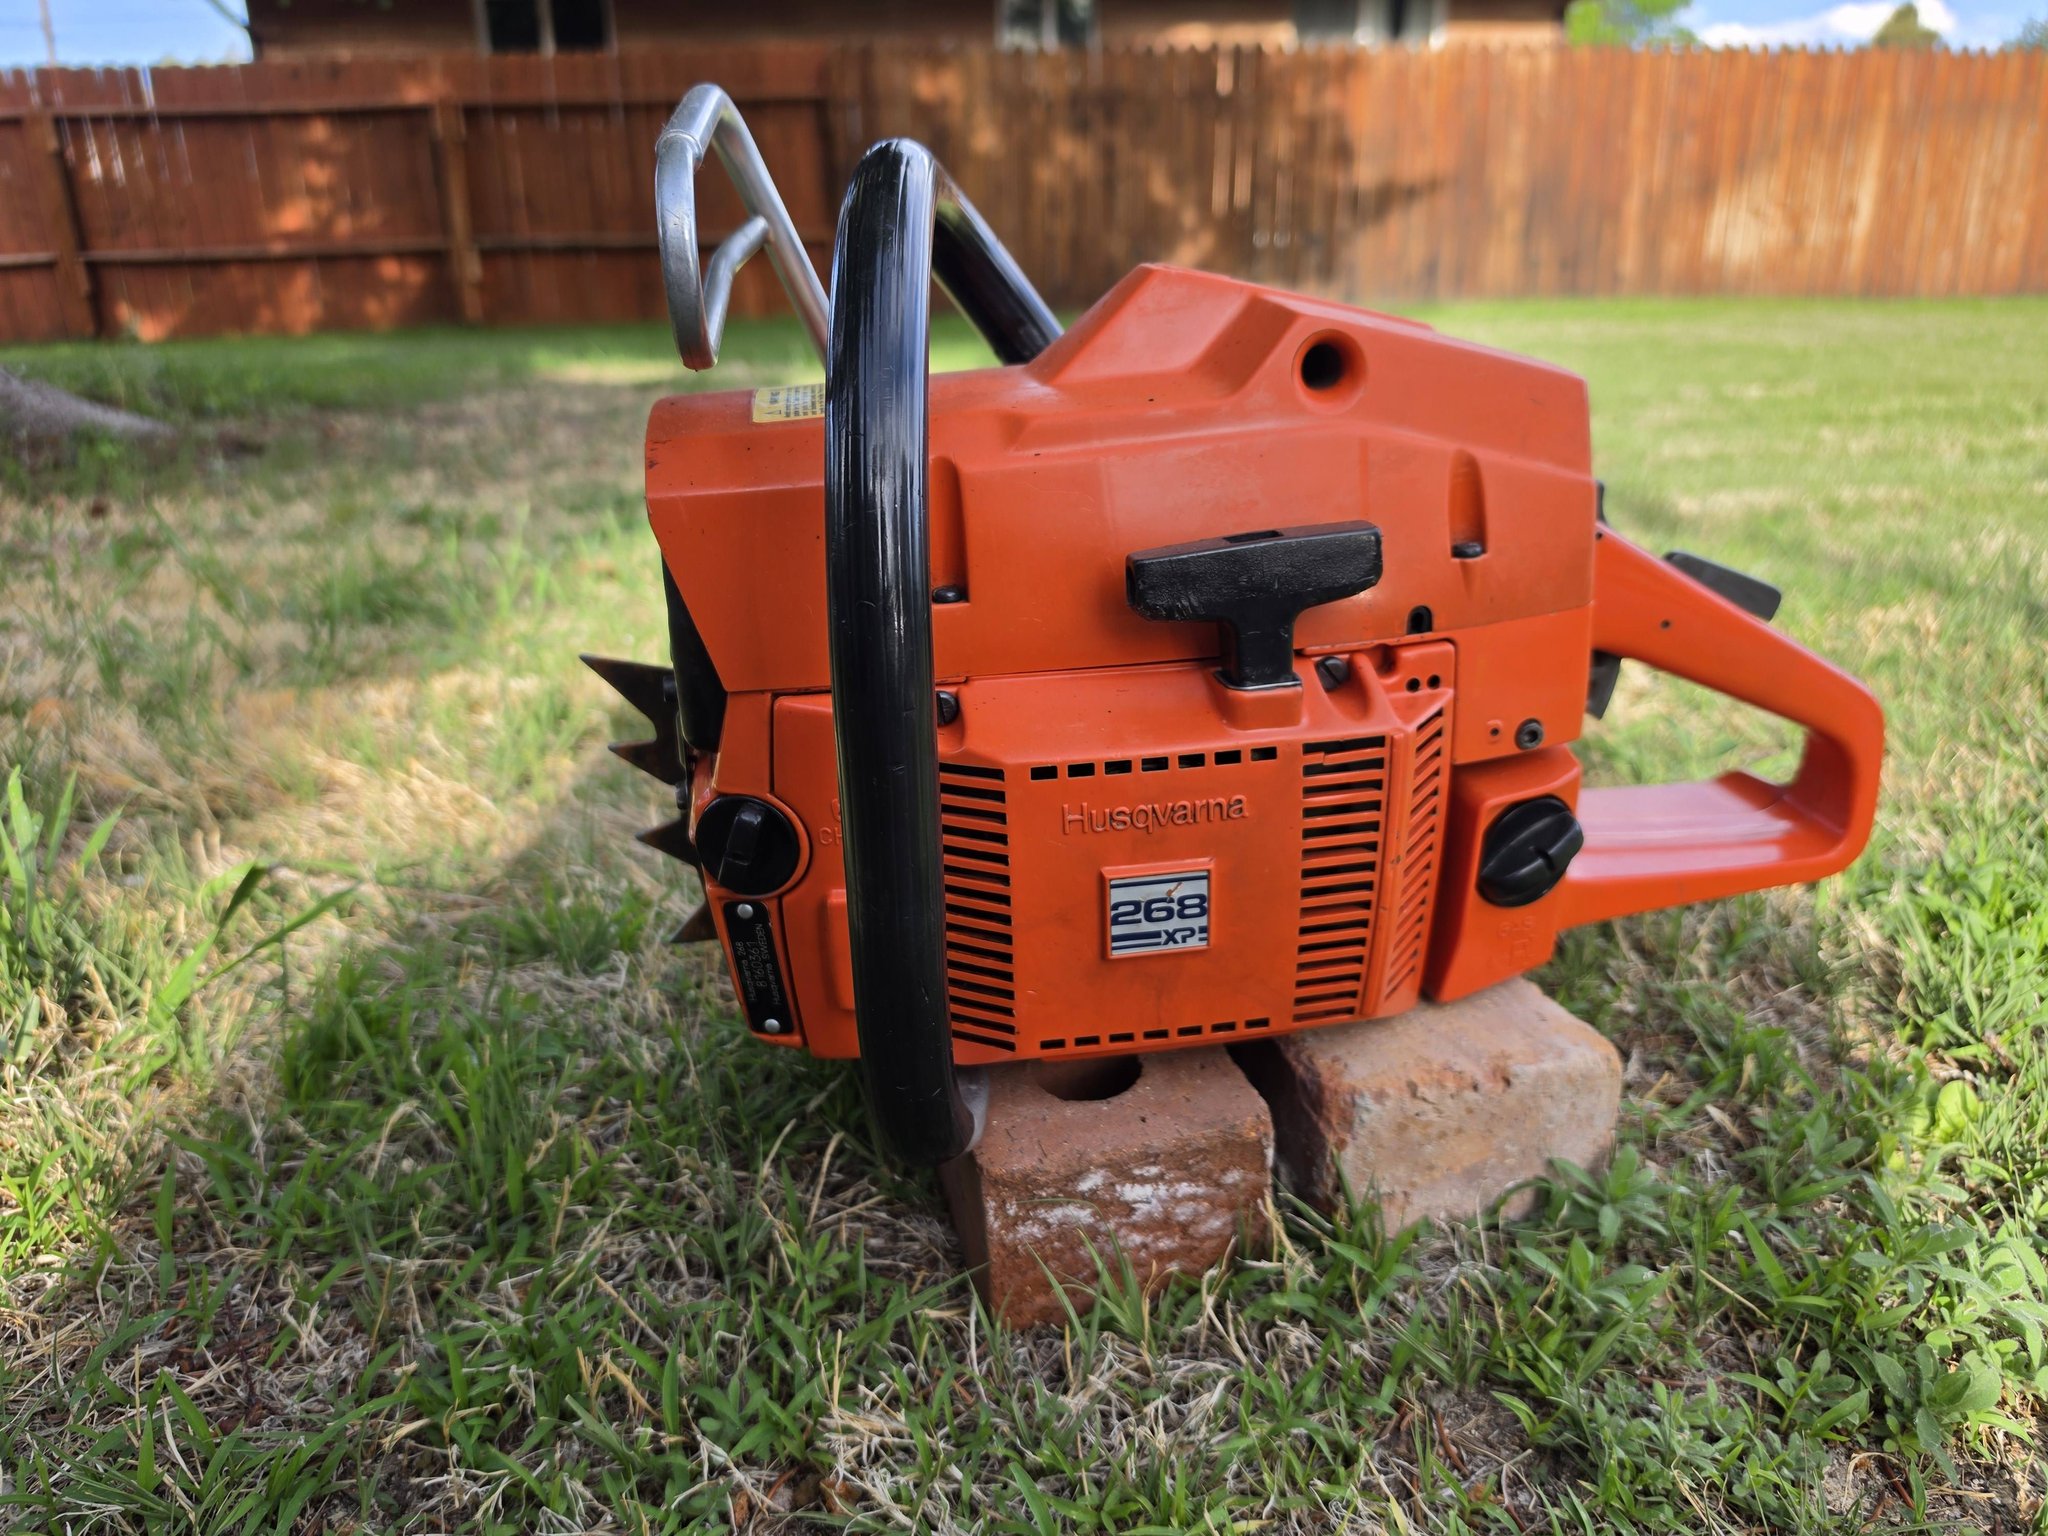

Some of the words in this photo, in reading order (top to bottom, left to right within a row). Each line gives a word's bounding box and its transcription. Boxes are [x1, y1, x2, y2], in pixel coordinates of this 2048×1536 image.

[1062, 794, 1249, 834] Husqvarna
[1111, 893, 1208, 926] 268
[736, 941, 746, 956] 268
[755, 923, 770, 960] SWEDEN
[1162, 926, 1196, 946] XP
